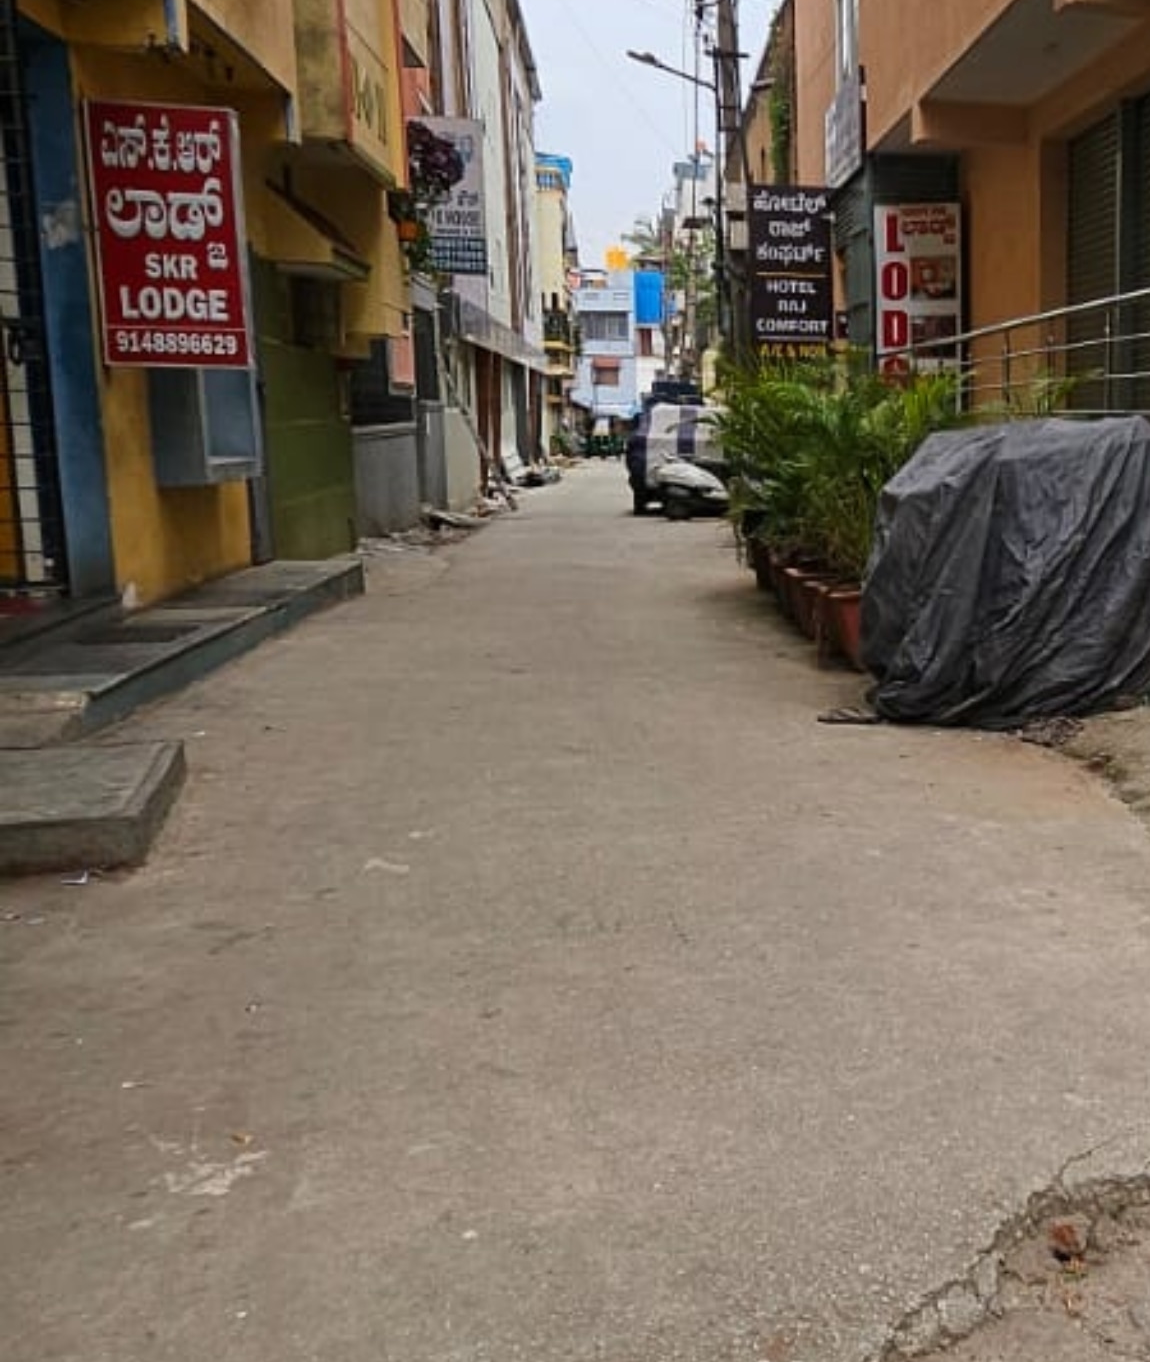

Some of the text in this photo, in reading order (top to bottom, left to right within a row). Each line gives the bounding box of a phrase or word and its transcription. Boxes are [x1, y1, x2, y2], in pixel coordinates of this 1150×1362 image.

[145, 253, 198, 280] SKR
[766, 280, 816, 294] HOTEL
[120, 286, 230, 322] LODGE
[756, 317, 828, 333] COMFORT
[117, 330, 238, 355] 9148896629
